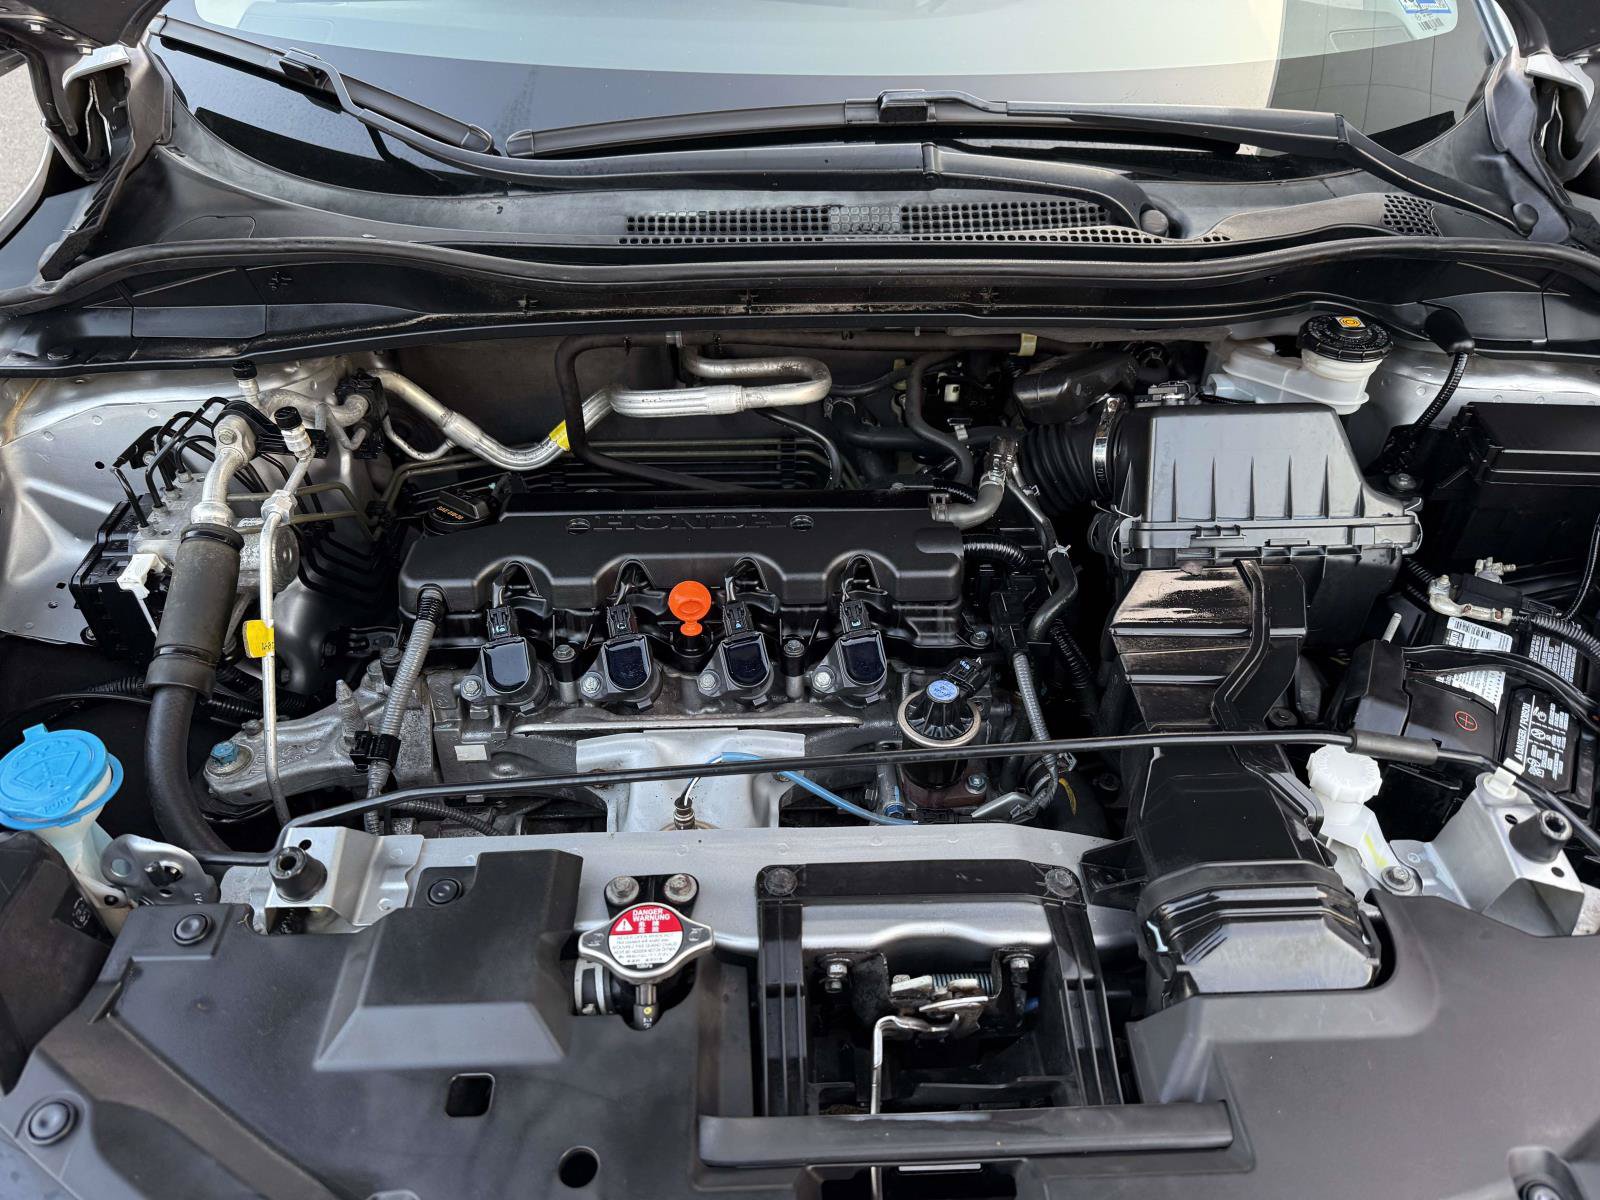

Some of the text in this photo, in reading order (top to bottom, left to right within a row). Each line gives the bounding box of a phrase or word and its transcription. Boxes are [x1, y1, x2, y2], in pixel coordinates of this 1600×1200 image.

[593, 514, 787, 530] HONDA
[1521, 702, 1531, 724] POISON
[1517, 728, 1528, 754] DANGER
[632, 908, 663, 916] DANGER
[632, 913, 670, 922] WARNUNG
